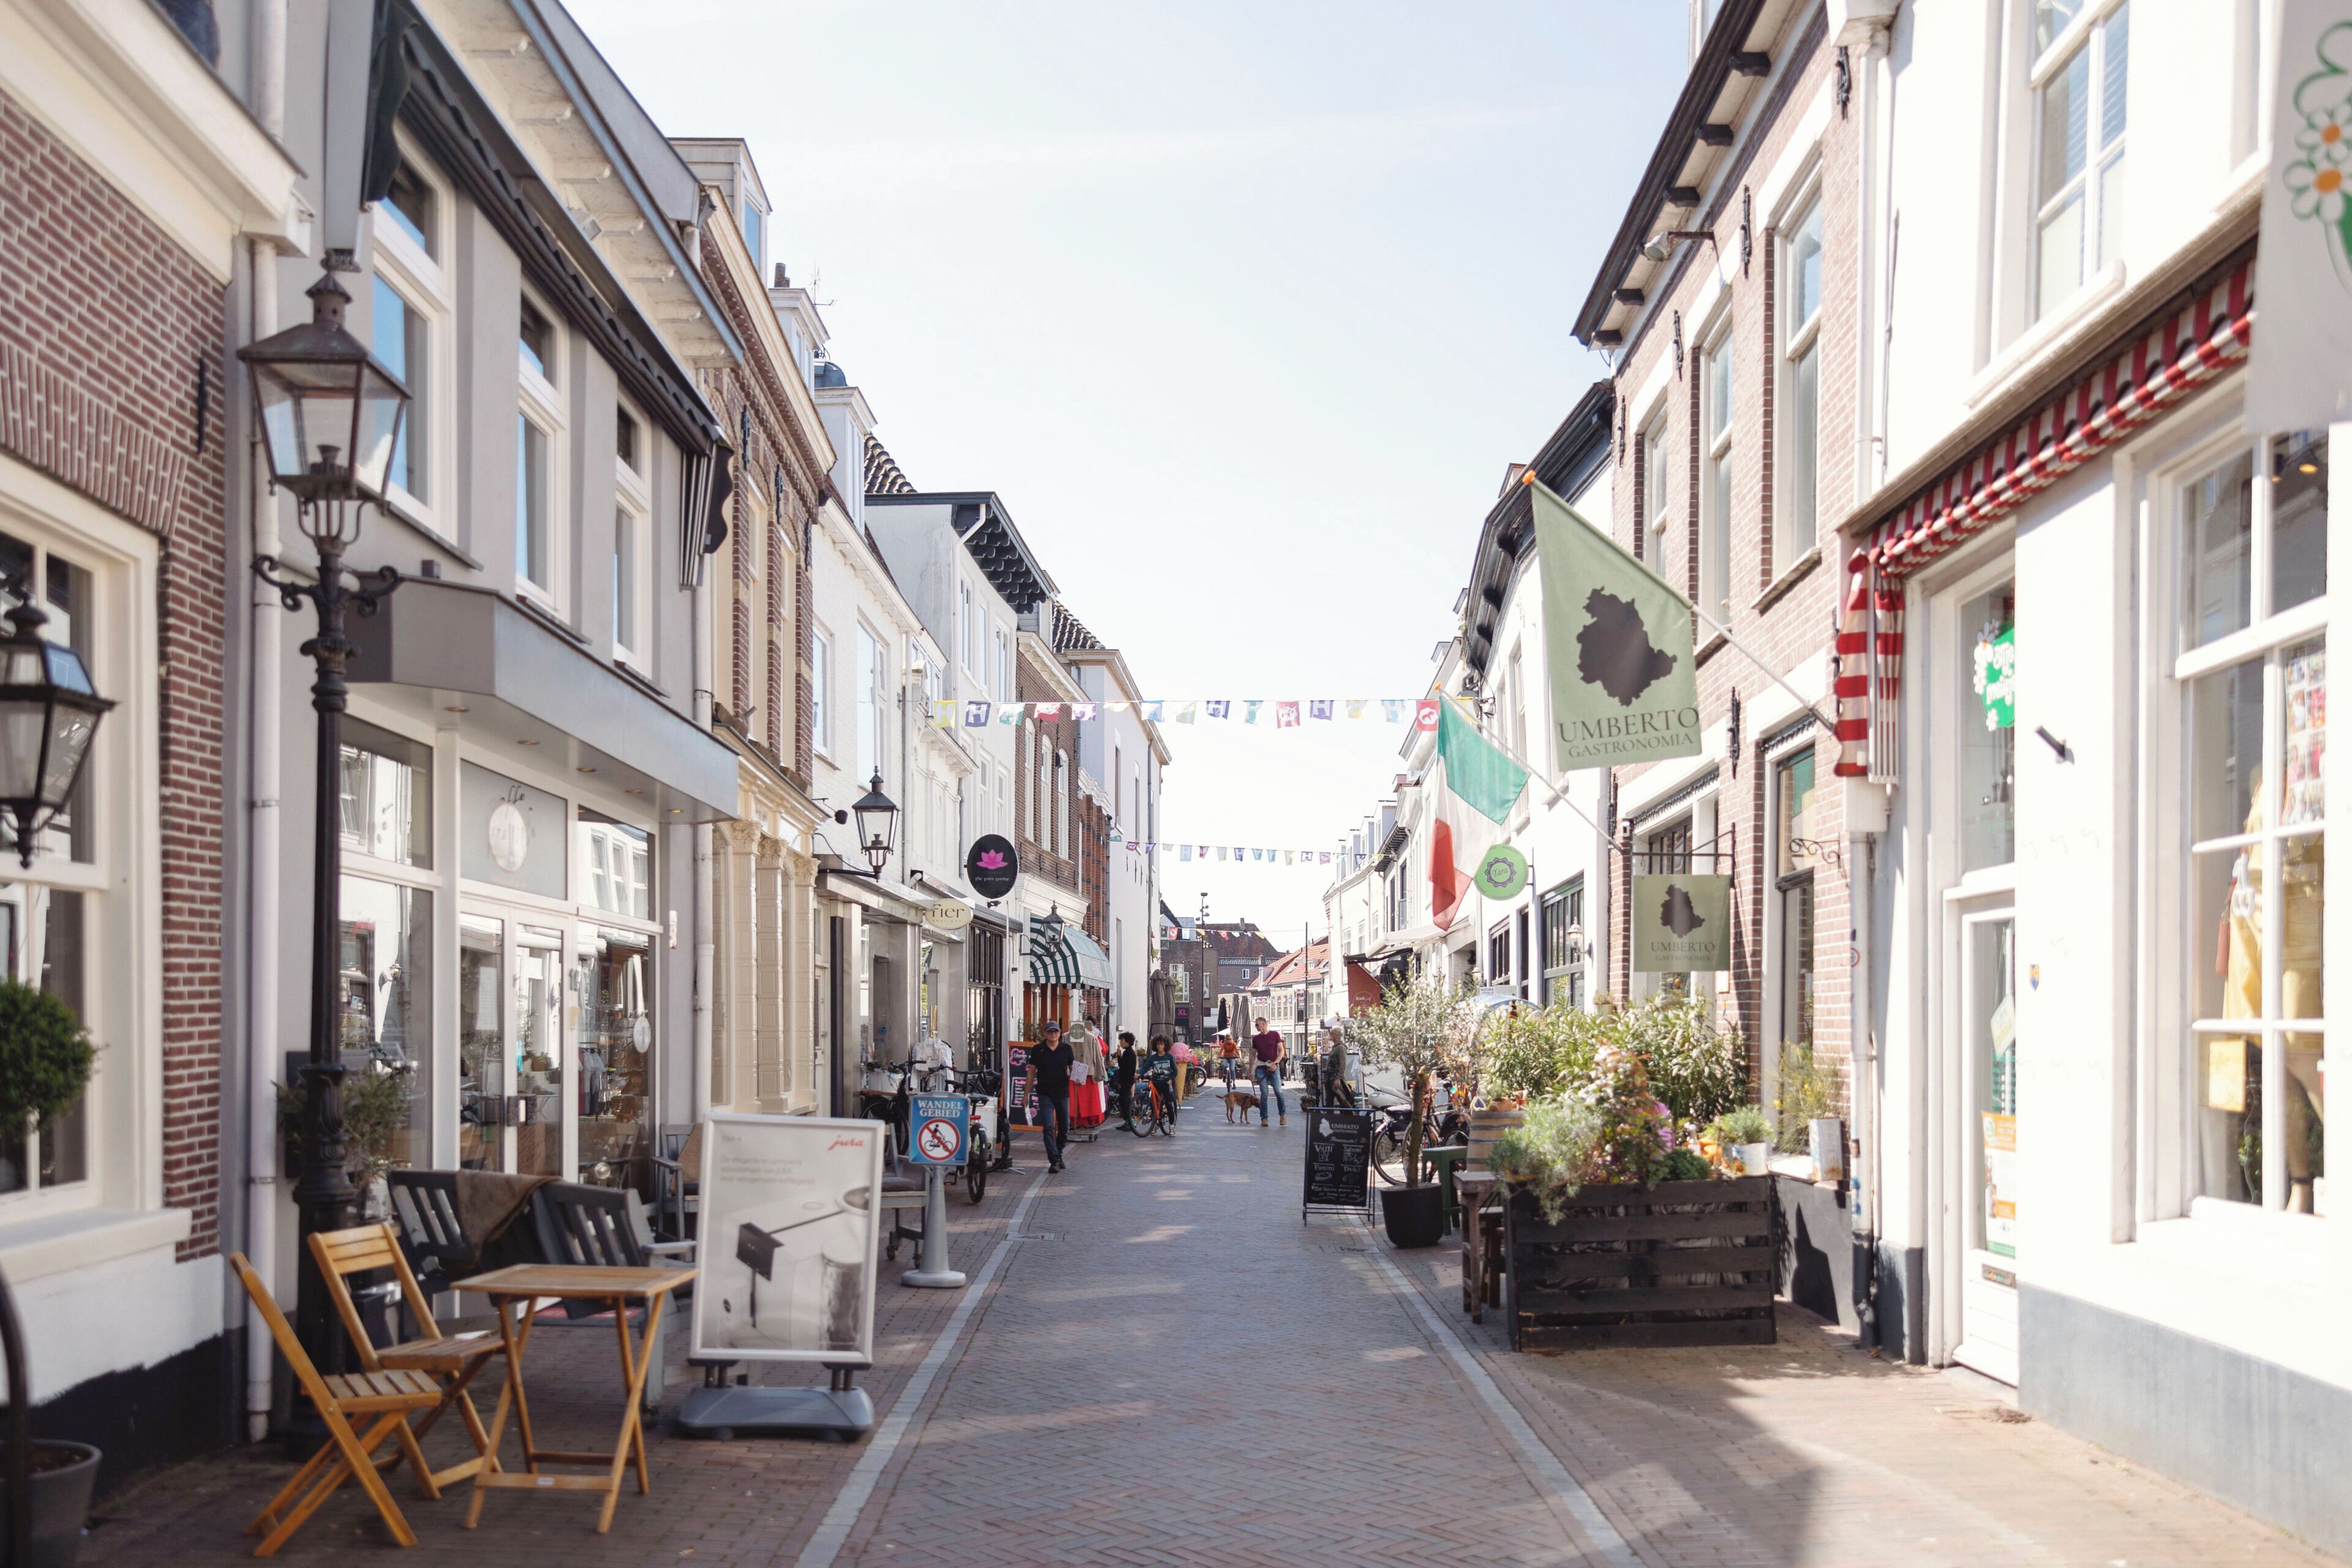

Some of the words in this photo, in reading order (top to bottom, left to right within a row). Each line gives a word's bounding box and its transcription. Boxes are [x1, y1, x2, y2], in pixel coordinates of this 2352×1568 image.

[1558, 707, 1700, 742] UMBERTO
[1569, 733, 1694, 758] GASTRONOMIA
[1491, 868, 1508, 877] Tara
[932, 903, 965, 918] fier
[1651, 941, 1715, 952] UMBERTO
[918, 1100, 963, 1109] WANDEL
[919, 1108, 960, 1118] GEBIED
[827, 1134, 865, 1151] jura
